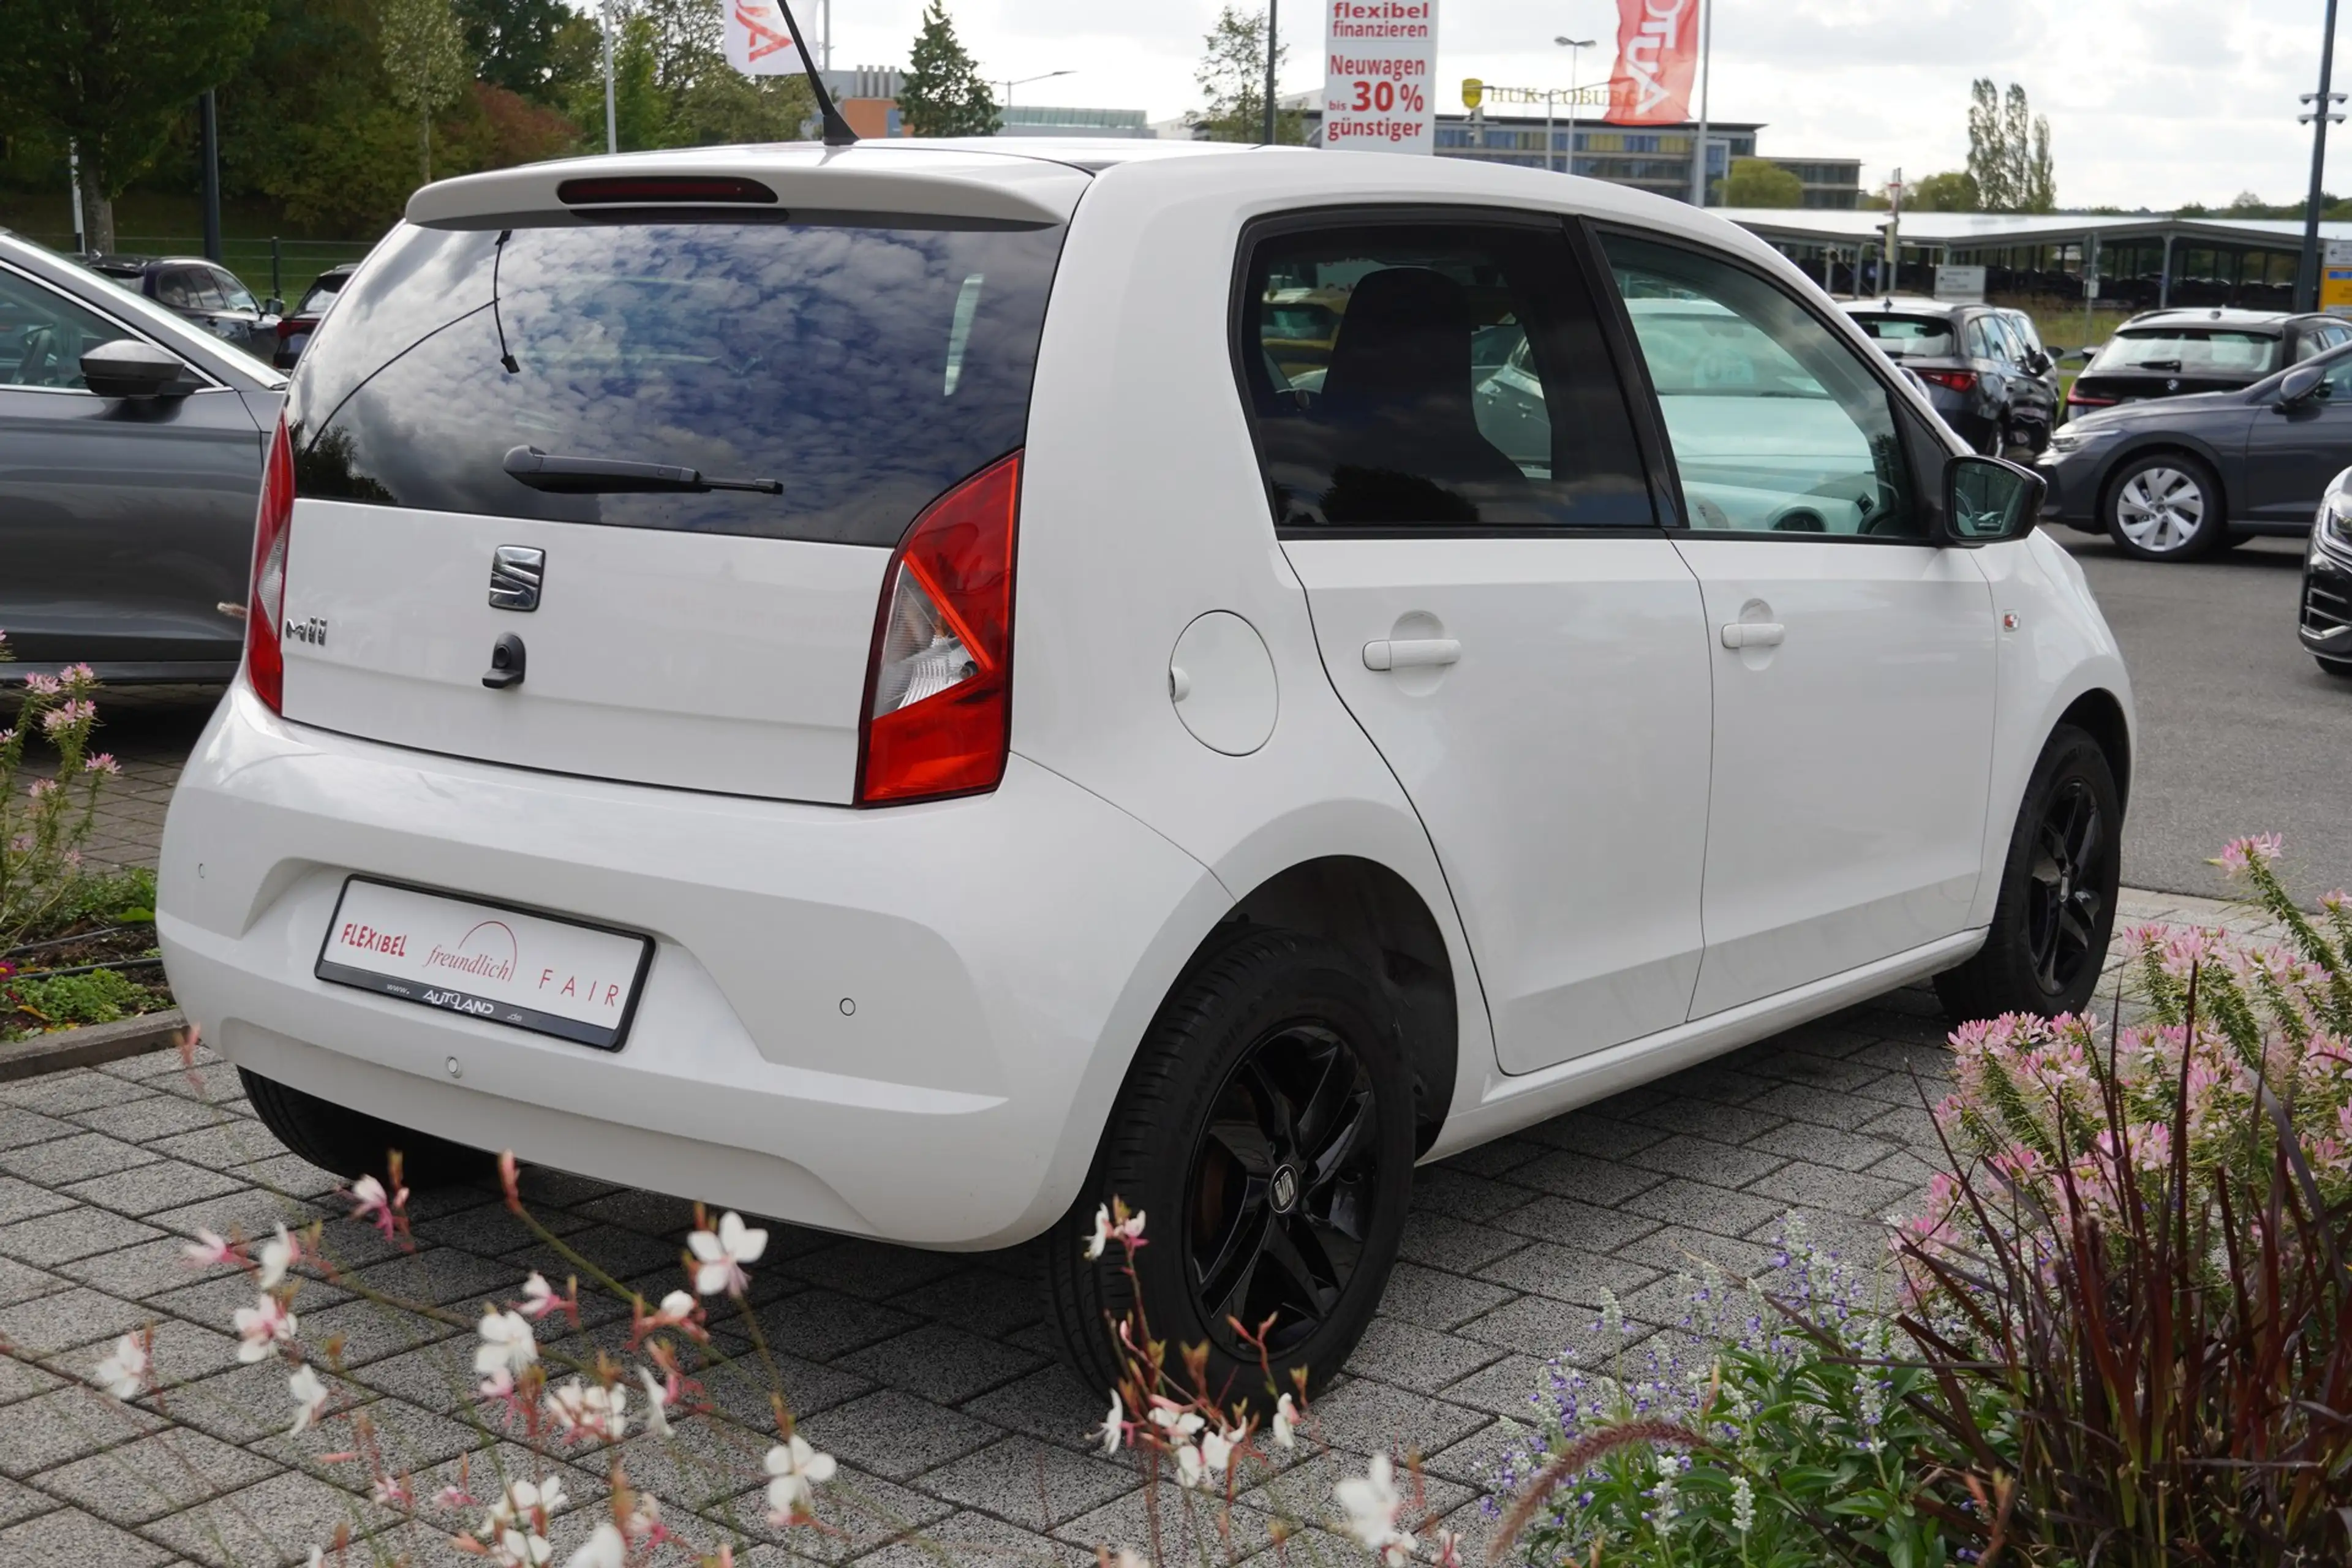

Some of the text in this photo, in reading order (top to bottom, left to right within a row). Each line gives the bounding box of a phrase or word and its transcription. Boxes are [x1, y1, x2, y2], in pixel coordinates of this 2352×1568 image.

[1333, 2, 1428, 19] flexibel
[1333, 20, 1428, 37] finanzieren
[1330, 55, 1425, 81] Neuwagen
[1328, 100, 1347, 111] bis
[1327, 117, 1423, 142] günstiger
[285, 616, 328, 647] Mii
[341, 922, 619, 1008] FLEXIBEL freundlich FAIR
[386, 983, 410, 995] www.
[423, 989, 494, 1014] AUTOLAND
